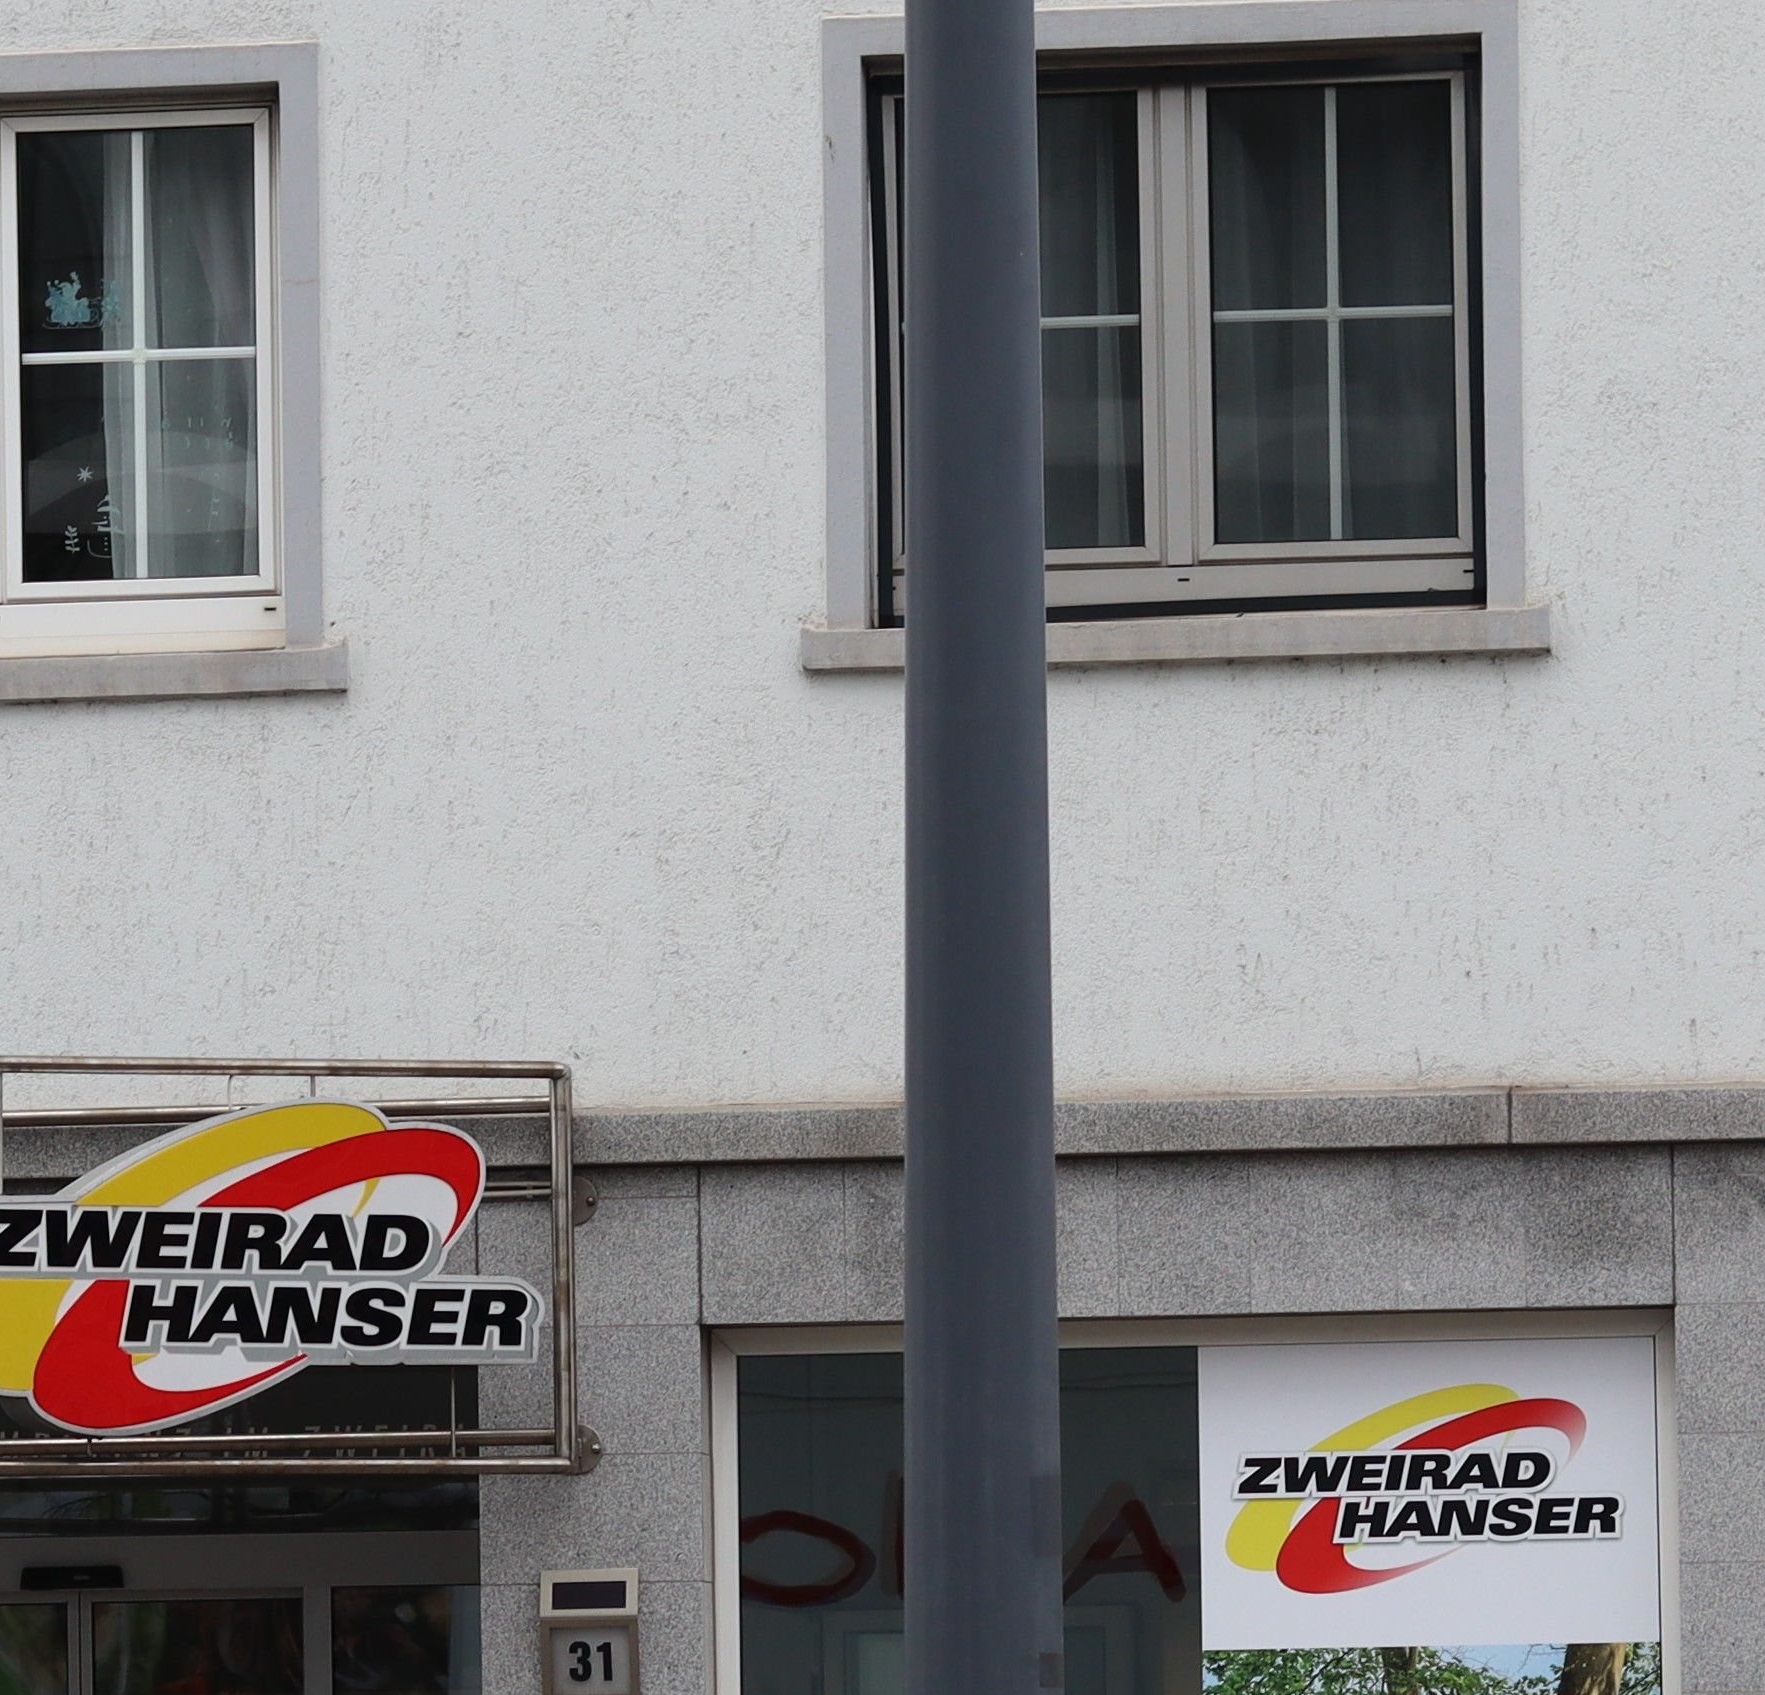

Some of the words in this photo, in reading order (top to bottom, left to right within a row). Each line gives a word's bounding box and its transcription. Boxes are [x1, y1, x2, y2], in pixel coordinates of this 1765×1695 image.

[123, 1283, 532, 1348] HANSER
[1237, 1453, 1552, 1494] ZWEIRAD
[1339, 1497, 1621, 1538] HANSER
[569, 1641, 613, 1682] 31
